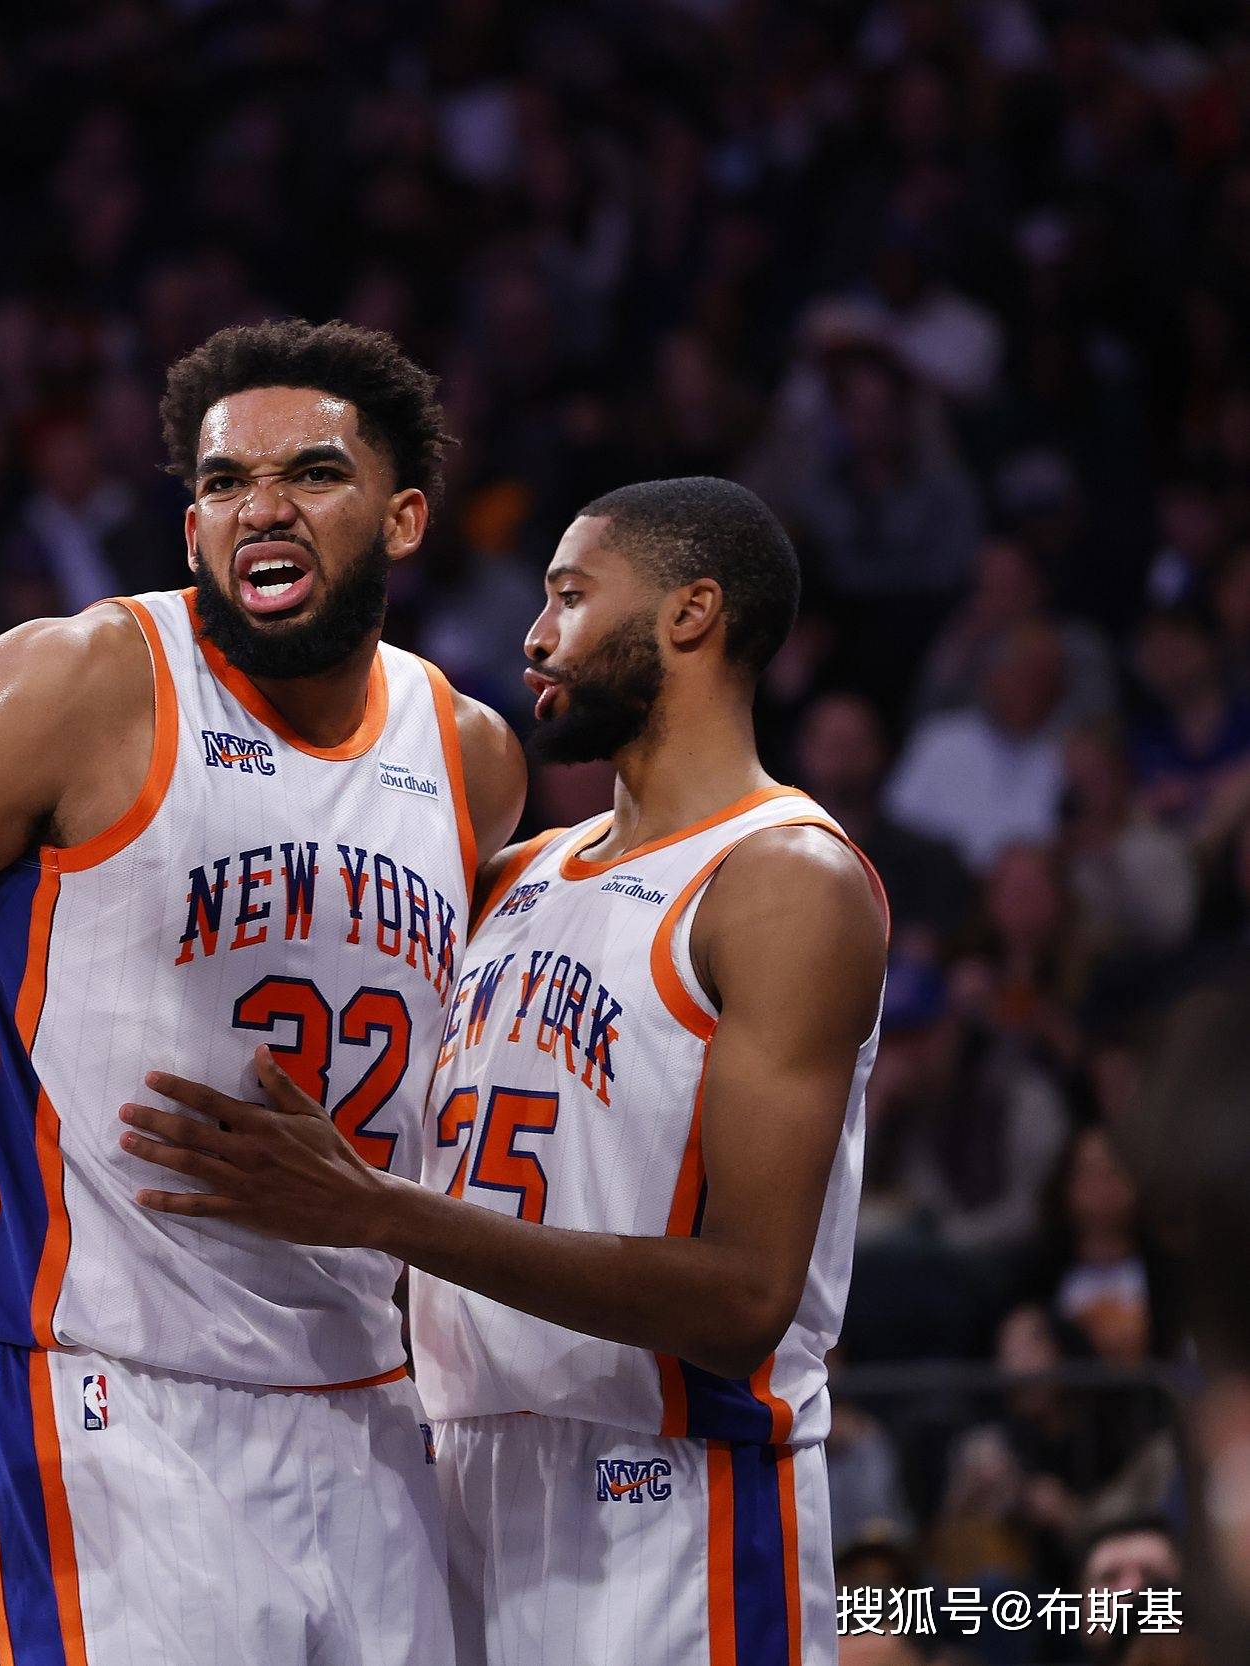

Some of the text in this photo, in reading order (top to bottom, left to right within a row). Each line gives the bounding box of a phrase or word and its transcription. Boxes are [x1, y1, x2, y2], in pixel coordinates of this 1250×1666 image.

[201, 729, 276, 776] NYC
[380, 772, 438, 796] abu dhabi
[174, 841, 457, 1008] NEW YORK
[601, 881, 669, 905] abu dhabi
[231, 974, 413, 1173] 32
[437, 950, 624, 1107] EW YORK
[436, 1085, 560, 1225] 25
[596, 1457, 672, 1503] NYC
